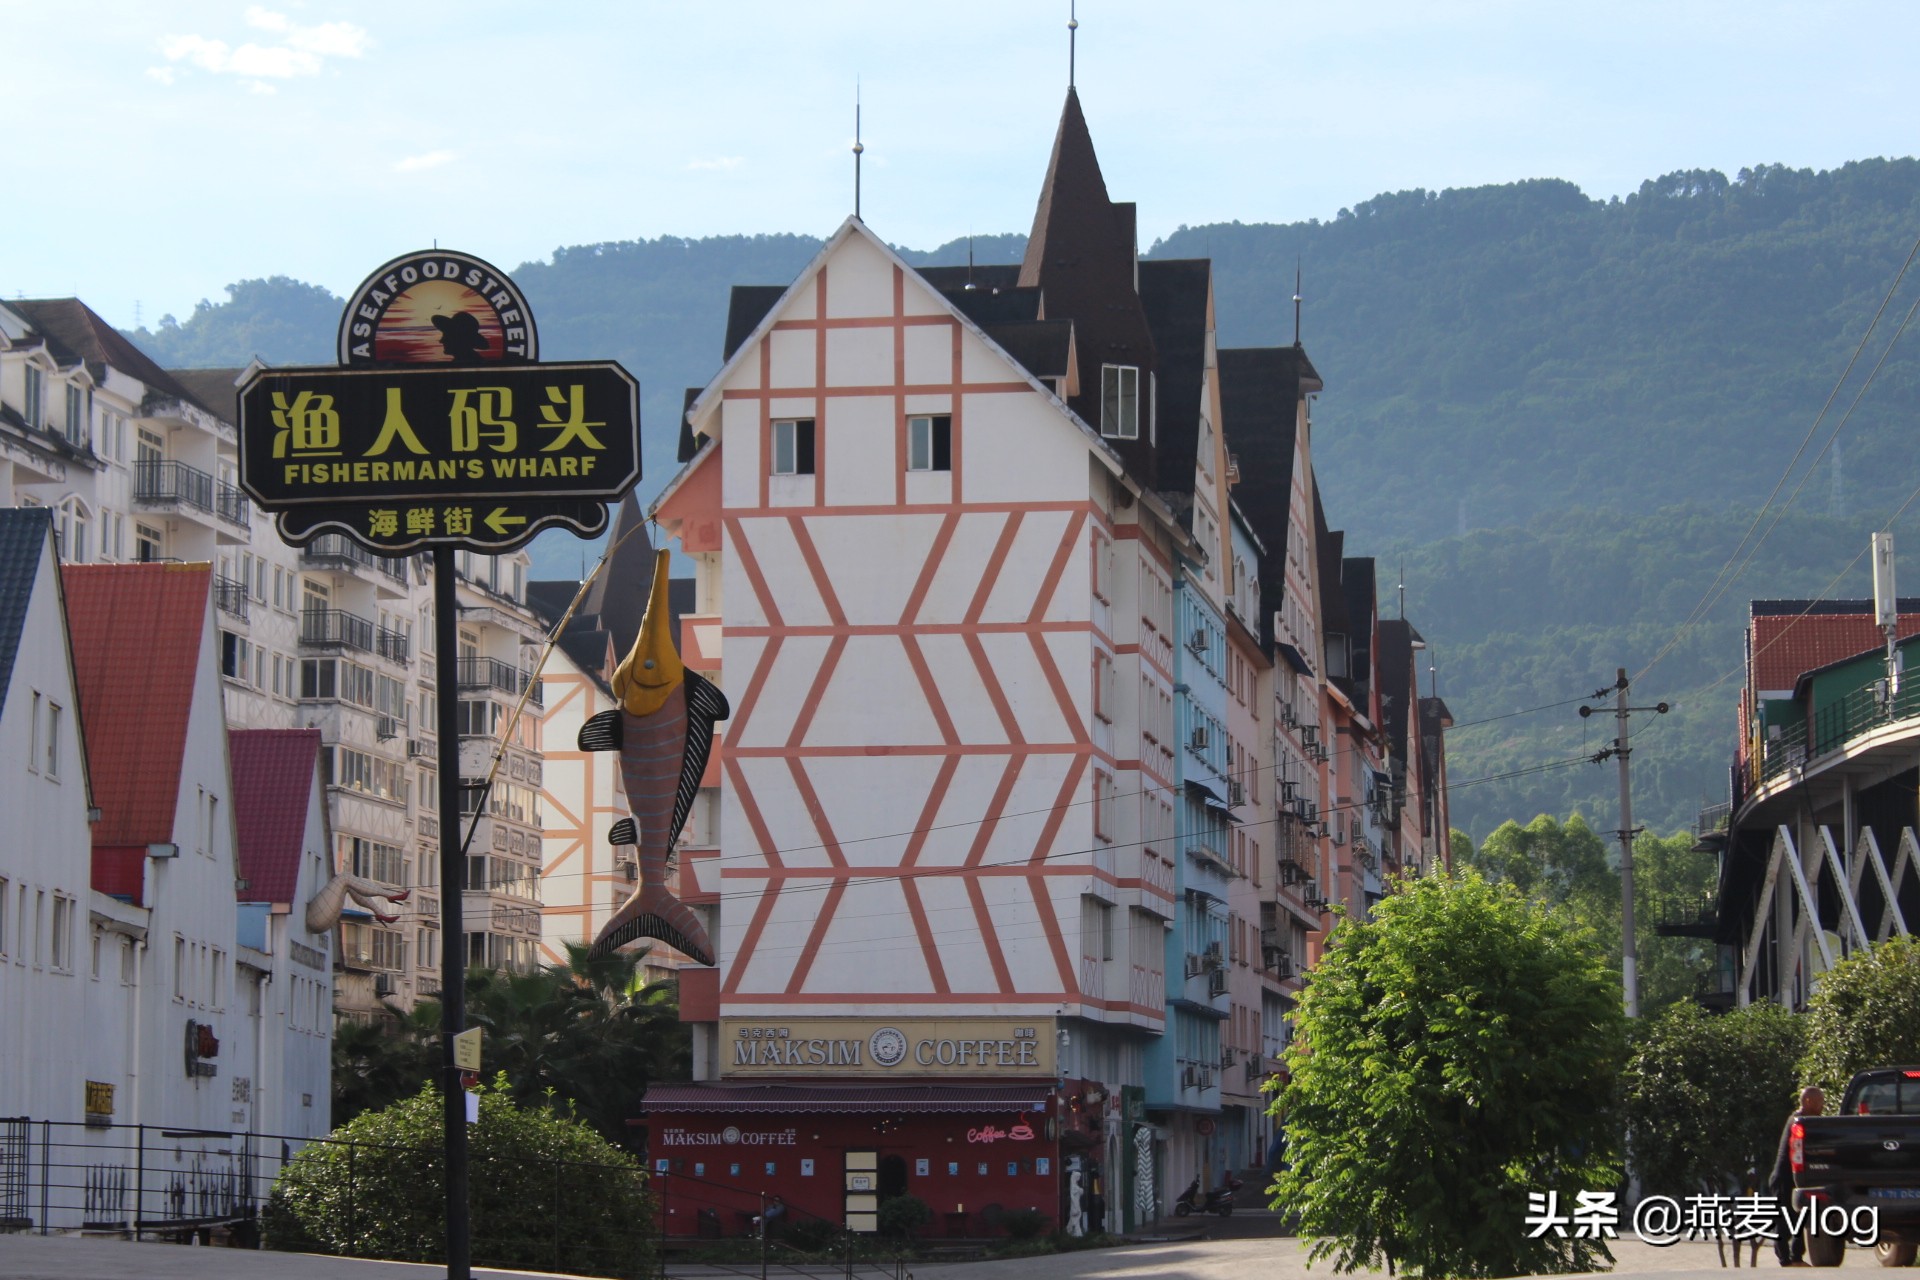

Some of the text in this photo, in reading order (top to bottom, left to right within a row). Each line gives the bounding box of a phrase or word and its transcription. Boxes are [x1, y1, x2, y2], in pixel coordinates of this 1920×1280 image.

[353, 261, 525, 358] A SEAFOOD STREET
[271, 384, 607, 458] 渔人码头
[285, 456, 596, 485] FISHERMAN'S WHARF
[369, 507, 473, 537] 海鲜街
[734, 1039, 864, 1066] MAKSIM
[914, 1039, 1040, 1066] COFFEE
[663, 1133, 797, 1146] MAKSIM COFFEE
[967, 1125, 1007, 1143] Coffee
